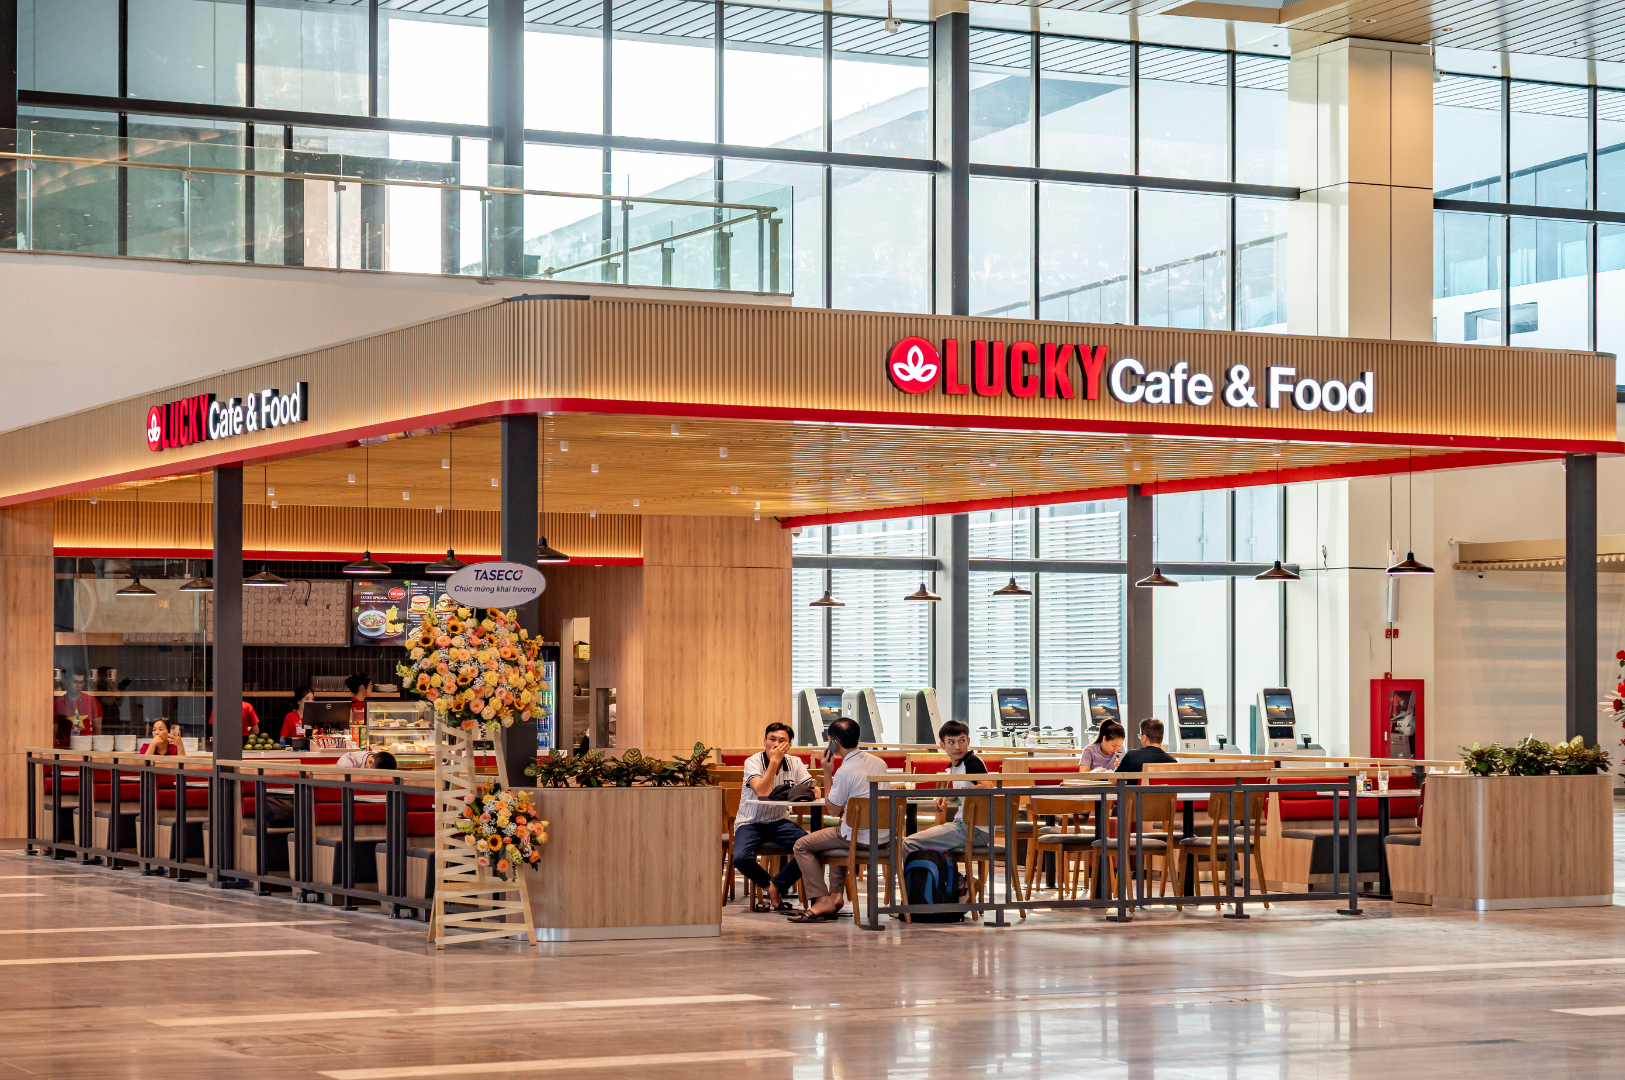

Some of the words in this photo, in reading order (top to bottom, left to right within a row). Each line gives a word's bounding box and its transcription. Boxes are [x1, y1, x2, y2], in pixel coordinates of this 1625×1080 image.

[943, 338, 1108, 400] LUCKY
[1109, 357, 1214, 406] Cafe
[1223, 363, 1258, 408] &
[1267, 366, 1374, 414] Food
[161, 393, 211, 449] LUCKY
[209, 397, 243, 440] Cafe
[246, 392, 258, 431] &
[261, 381, 302, 430] Food
[474, 569, 523, 581] TASECO
